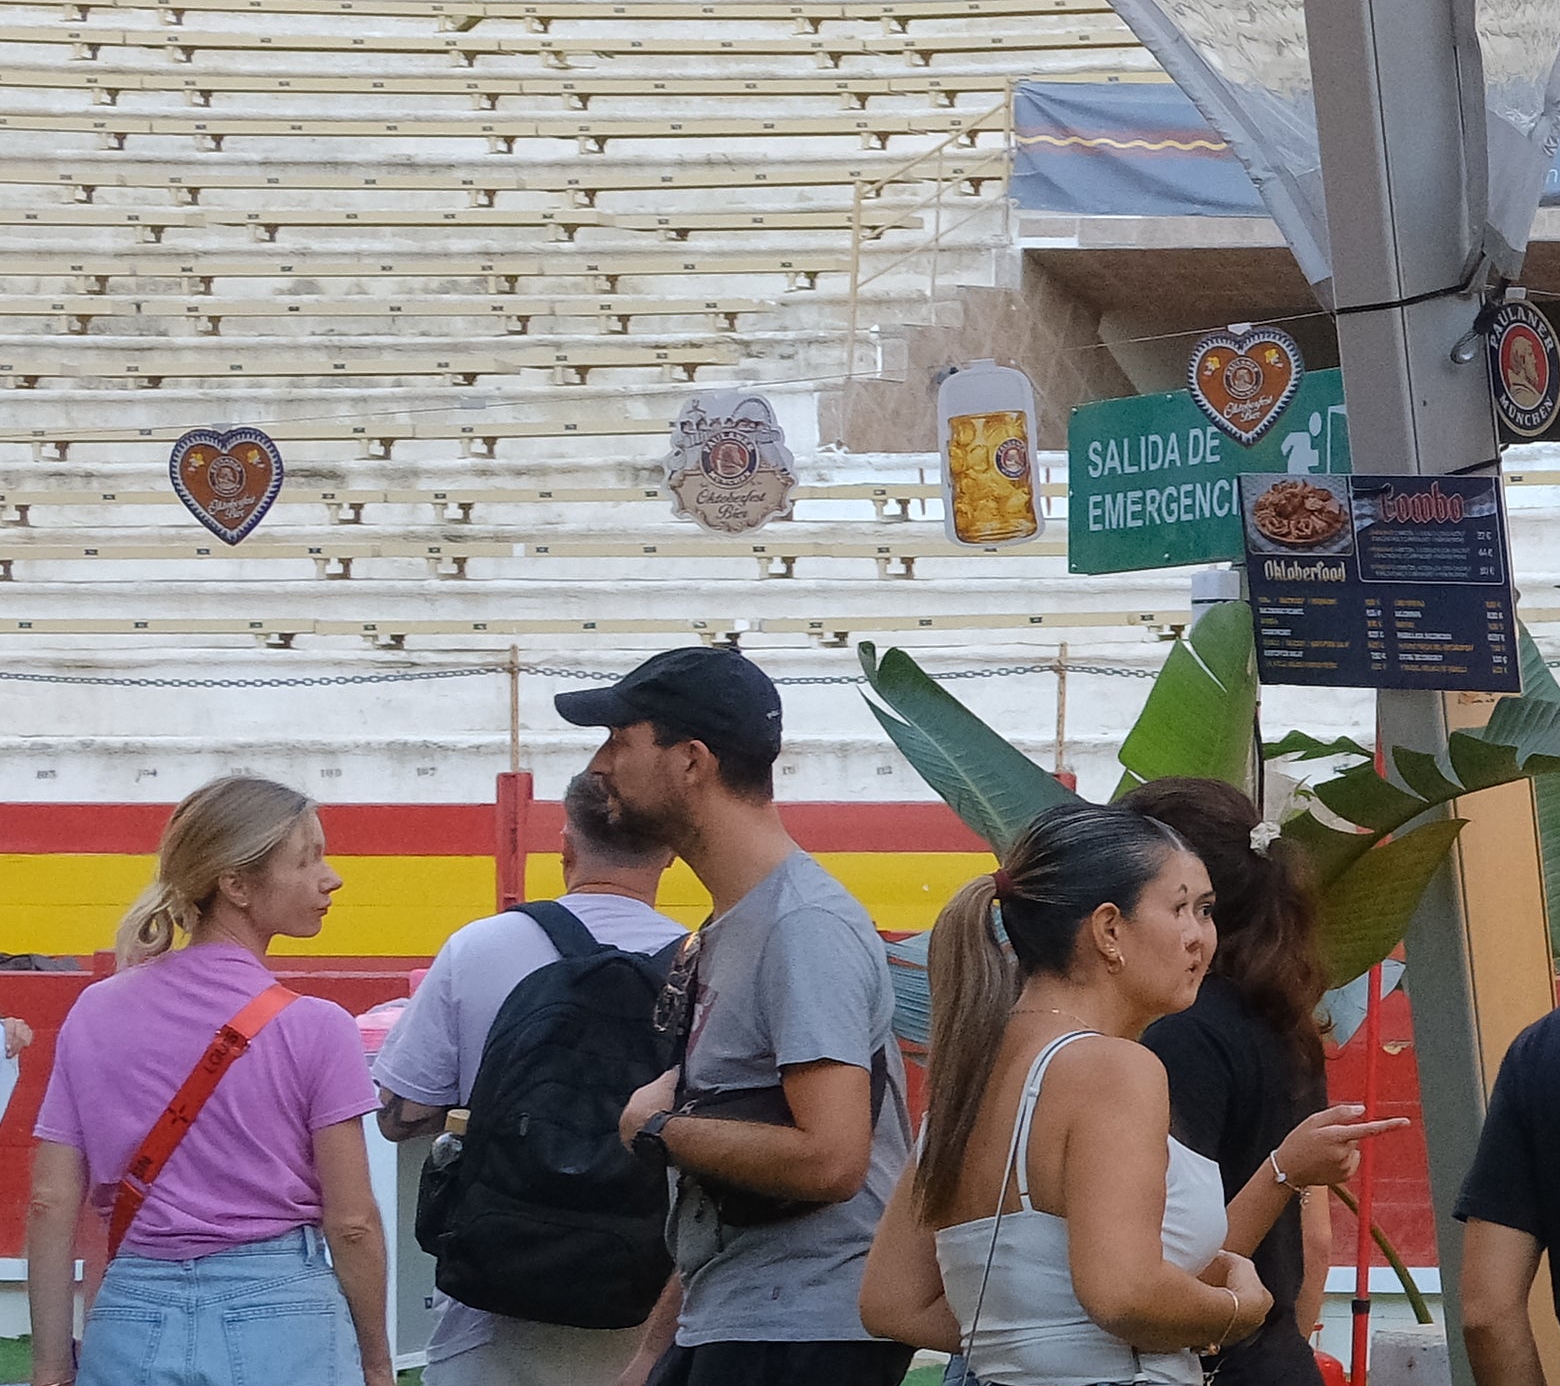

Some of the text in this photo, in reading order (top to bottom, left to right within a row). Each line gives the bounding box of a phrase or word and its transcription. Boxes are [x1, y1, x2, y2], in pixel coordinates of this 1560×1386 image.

[1490, 306, 1555, 353] PAULANER
[1087, 426, 1221, 479] SALIDA DE
[696, 489, 767, 506] Oktoberfest
[1088, 478, 1241, 532] EMERGENCI
